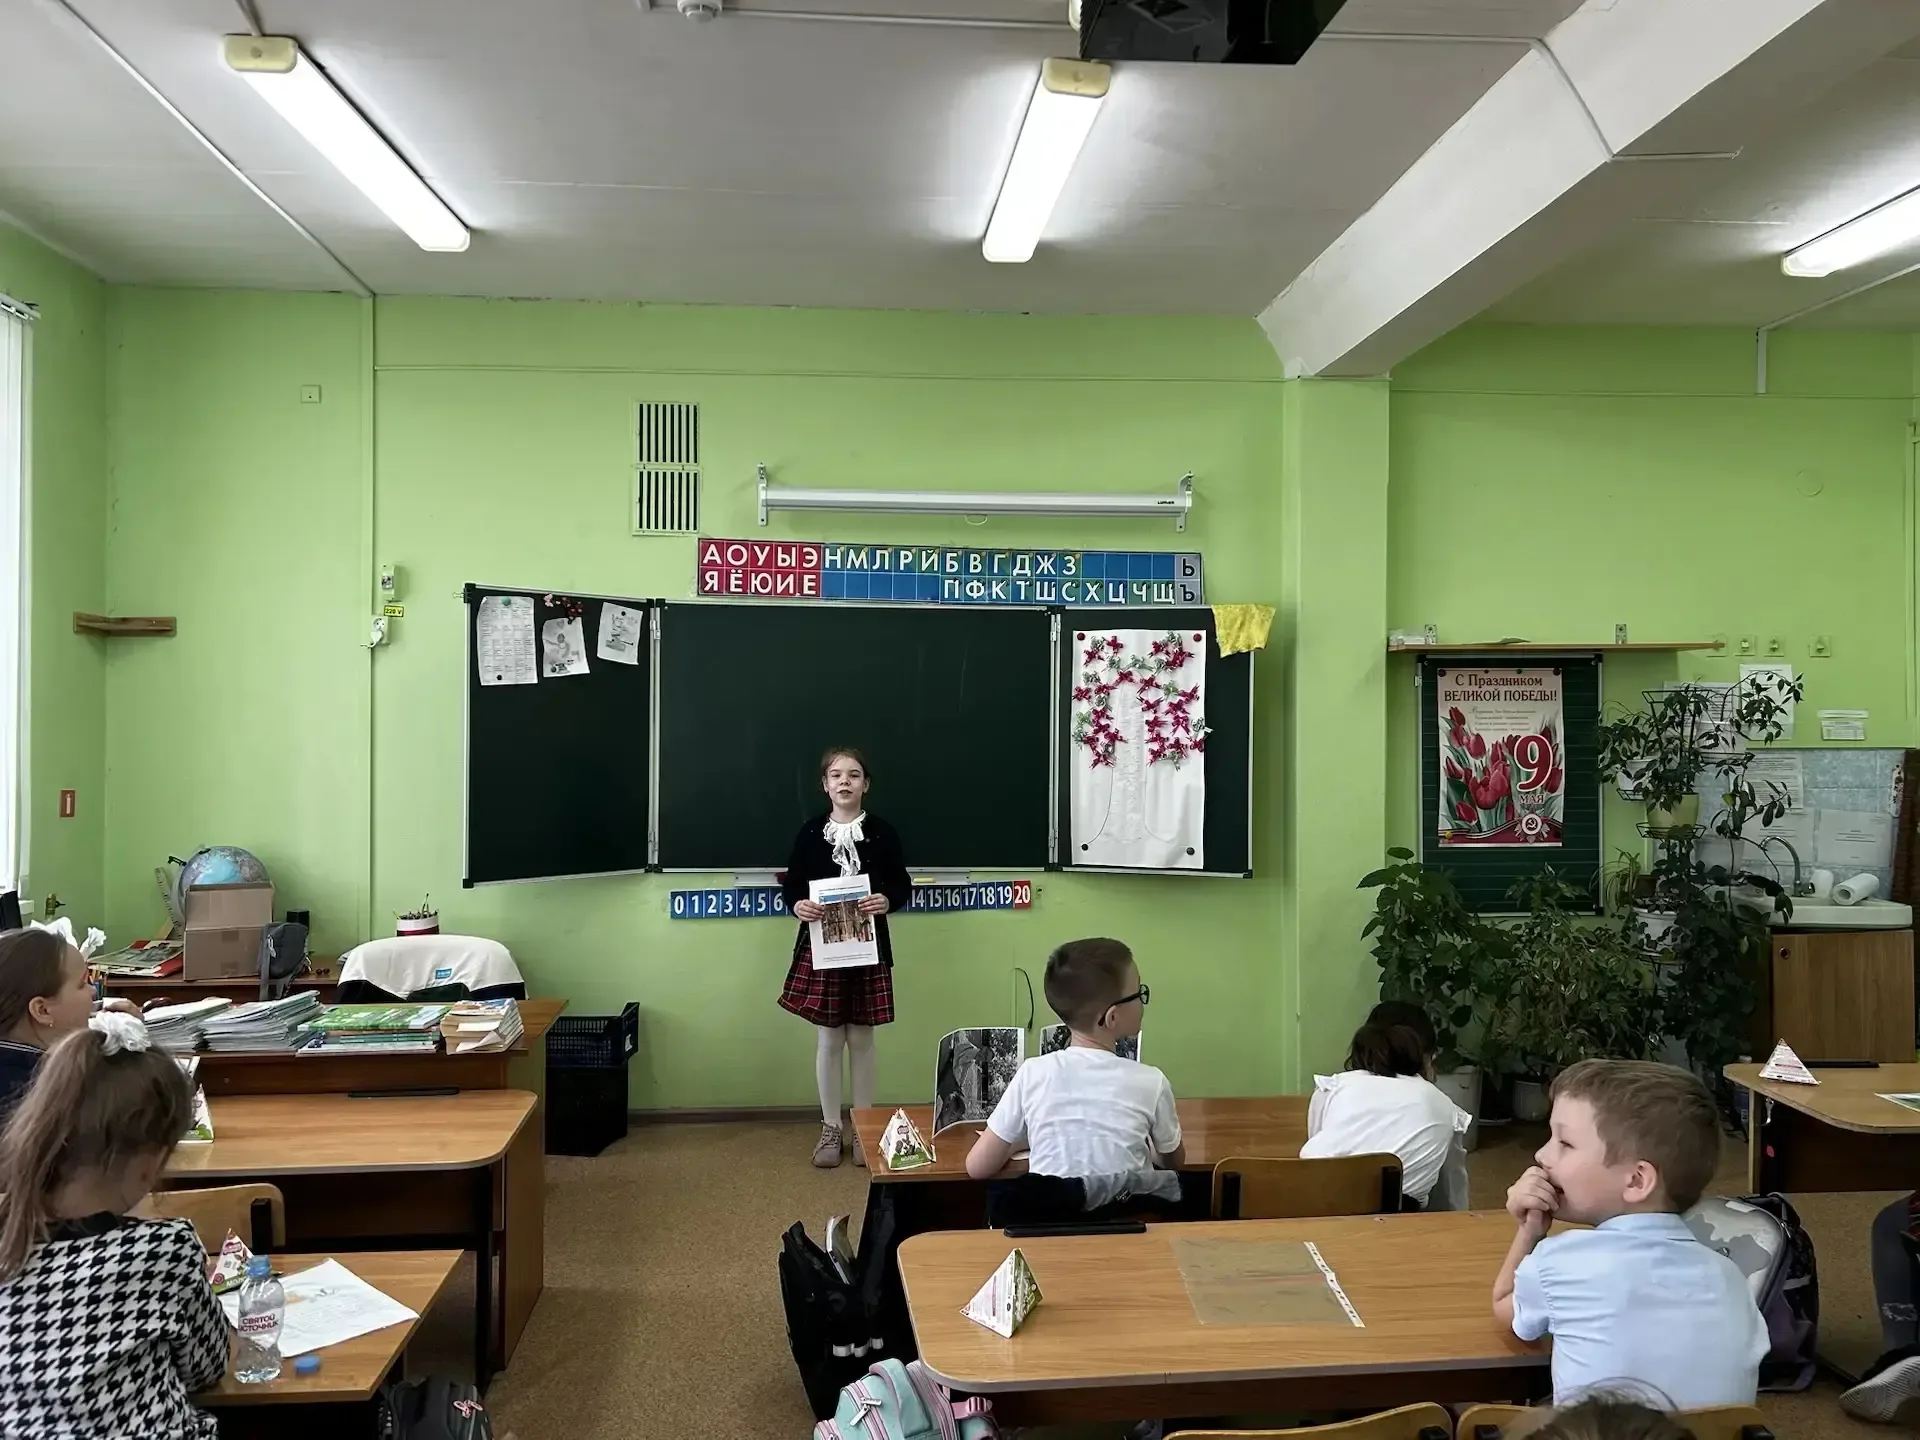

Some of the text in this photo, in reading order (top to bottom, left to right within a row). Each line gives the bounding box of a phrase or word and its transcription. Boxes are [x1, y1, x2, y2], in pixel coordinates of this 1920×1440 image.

[1455, 674, 1543, 688] С Праздником
[1444, 688, 1557, 702] ВЕЛИКОЙ ПОБЕДЫ!
[1514, 734, 1553, 792] 9
[1519, 793, 1545, 804] МАЯ
[674, 885, 1031, 914] 0 1 2 3 4 5 6 14 15 16 17 18 19 20
